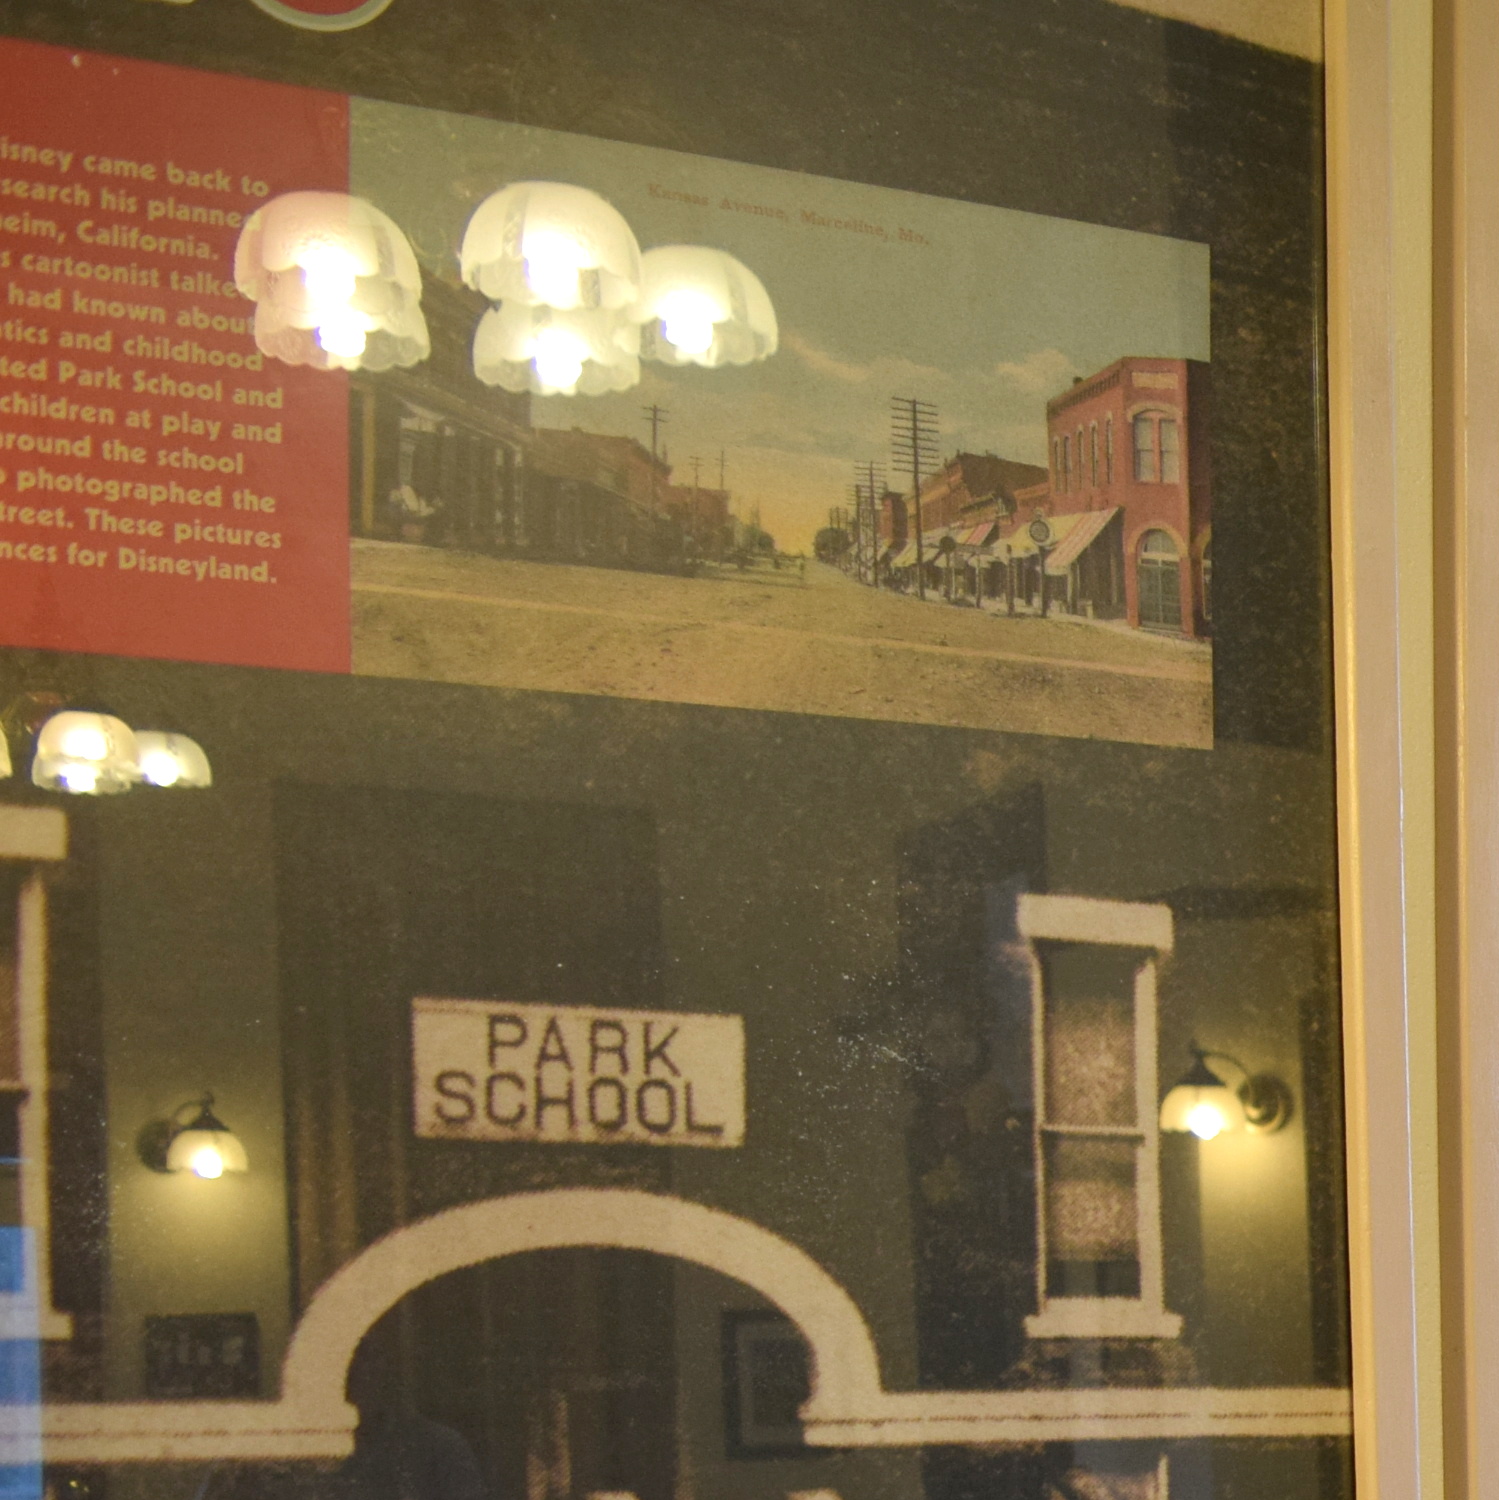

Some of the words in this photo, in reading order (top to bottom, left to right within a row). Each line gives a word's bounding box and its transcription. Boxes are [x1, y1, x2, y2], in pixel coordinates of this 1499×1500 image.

[82, 155, 155, 180] came
[166, 161, 229, 190] back
[241, 175, 268, 196] to
[100, 188, 136, 212] his
[647, 183, 709, 207] Kansas
[720, 197, 789, 222] Avenue,
[800, 209, 889, 241] Marceline,
[0, 215, 65, 242] eim,
[76, 219, 217, 259] California.
[21, 254, 158, 287] cartoonist
[8, 282, 61, 310] had
[73, 291, 165, 323] known
[0, 319, 48, 344] tics
[58, 330, 111, 352] and
[123, 335, 262, 370] childhood
[58, 360, 121, 389] Park
[132, 370, 222, 401] School
[232, 387, 282, 408] and
[0, 393, 115, 424] children
[125, 409, 151, 429] at
[161, 412, 220, 440] play
[231, 422, 282, 443] and
[0, 432, 91, 457] round
[102, 439, 146, 463] the
[157, 448, 243, 474] school
[16, 468, 222, 507] photographed
[232, 488, 275, 513] the
[84, 507, 163, 537] These
[174, 519, 281, 548] pictures
[66, 542, 107, 567] for
[118, 547, 276, 583] Disneyland.
[487, 1014, 682, 1077] PARK
[434, 1070, 725, 1136] SCHOOL
